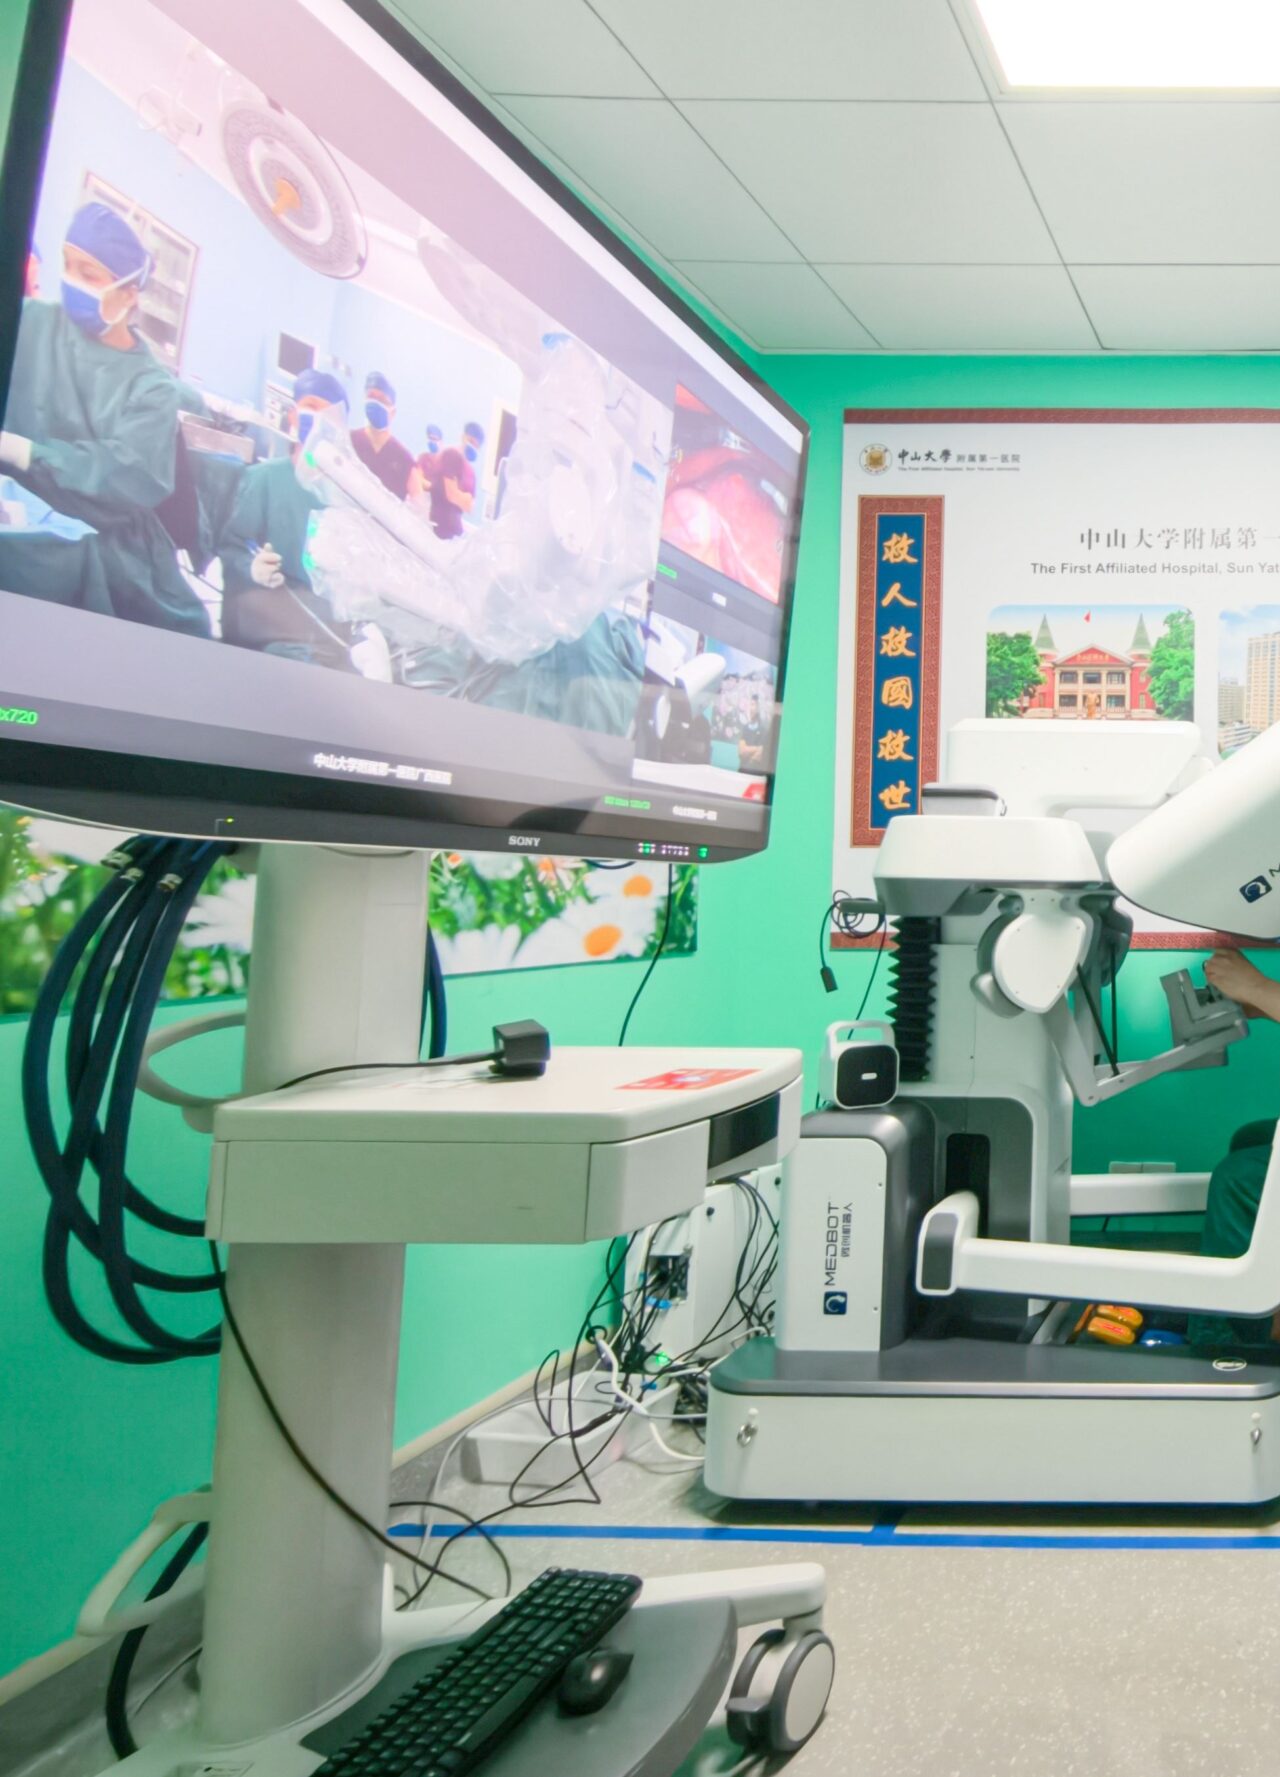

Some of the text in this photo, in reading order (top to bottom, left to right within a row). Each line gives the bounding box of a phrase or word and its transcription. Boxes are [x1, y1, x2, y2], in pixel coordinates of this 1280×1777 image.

[1030, 562, 1057, 575] The
[1060, 562, 1092, 575] First
[1095, 562, 1158, 575] Affiliated
[1161, 562, 1223, 577] Hospital,
[1226, 562, 1255, 575] Sun
[508, 835, 541, 847] SONY
[824, 1201, 839, 1286] MEDBOT
